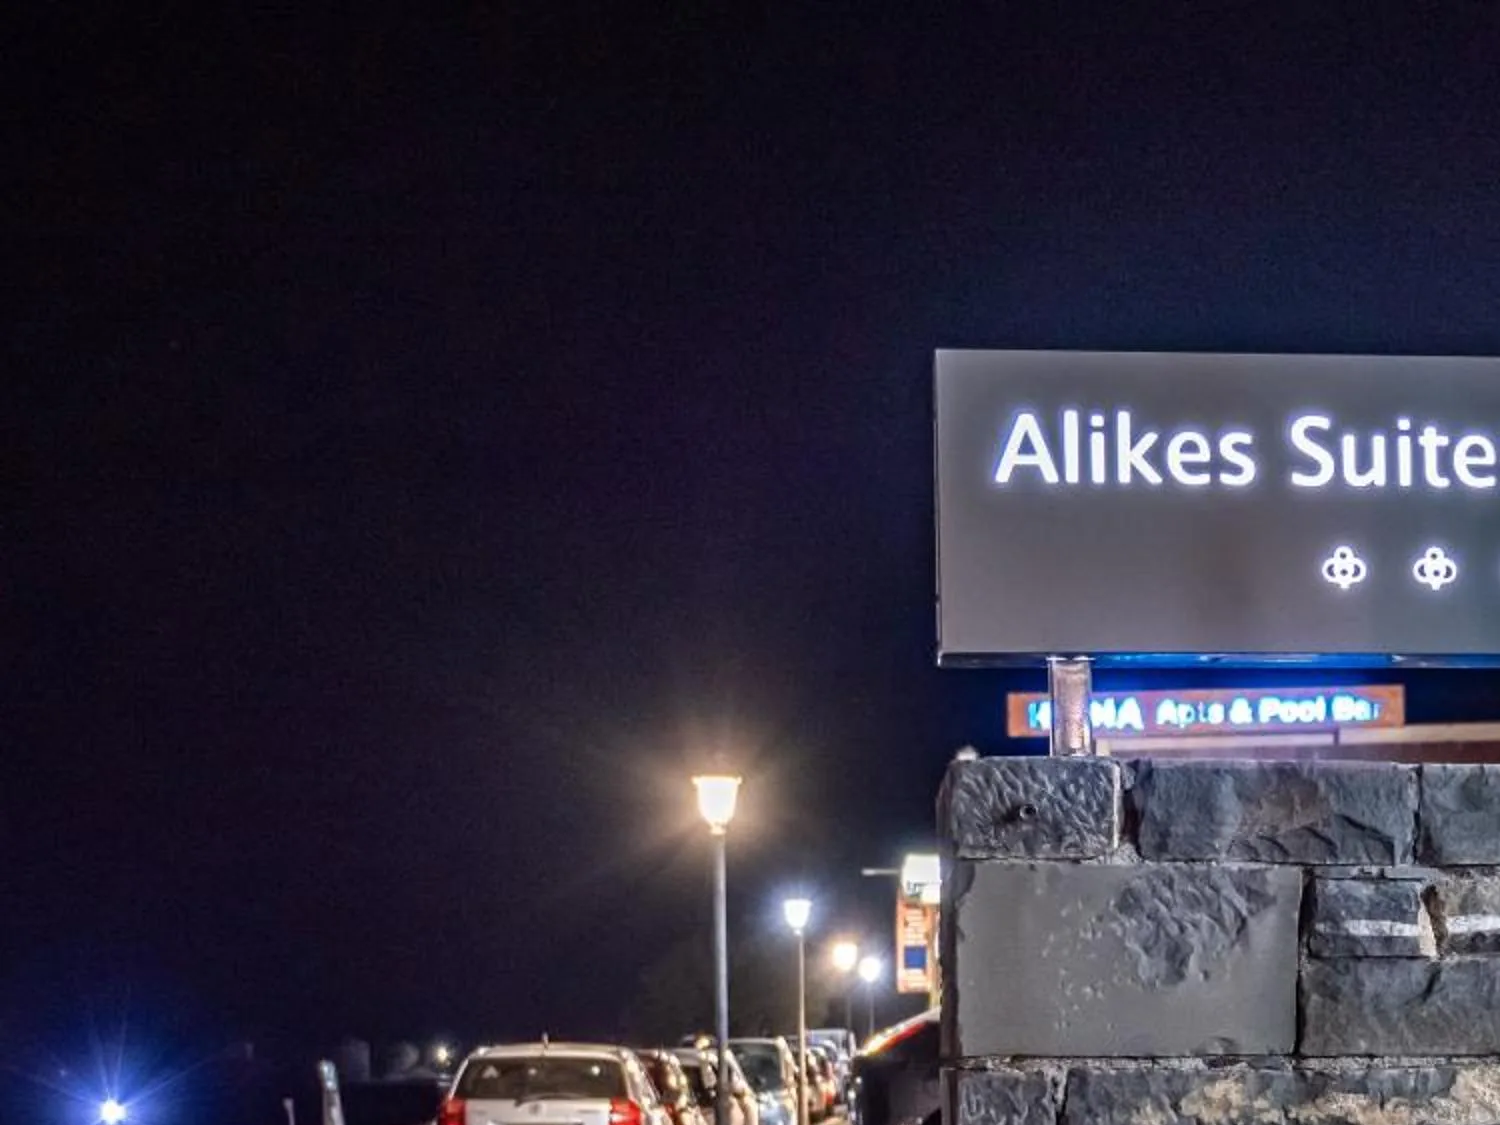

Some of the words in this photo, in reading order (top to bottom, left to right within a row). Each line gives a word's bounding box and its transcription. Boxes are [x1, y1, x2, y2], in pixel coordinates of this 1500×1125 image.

[993, 409, 1257, 487] Alikes
[1156, 698, 1225, 728] Apts
[1229, 696, 1253, 725] &
[1258, 695, 1326, 723] Pool
[1331, 694, 1380, 721] Bar
